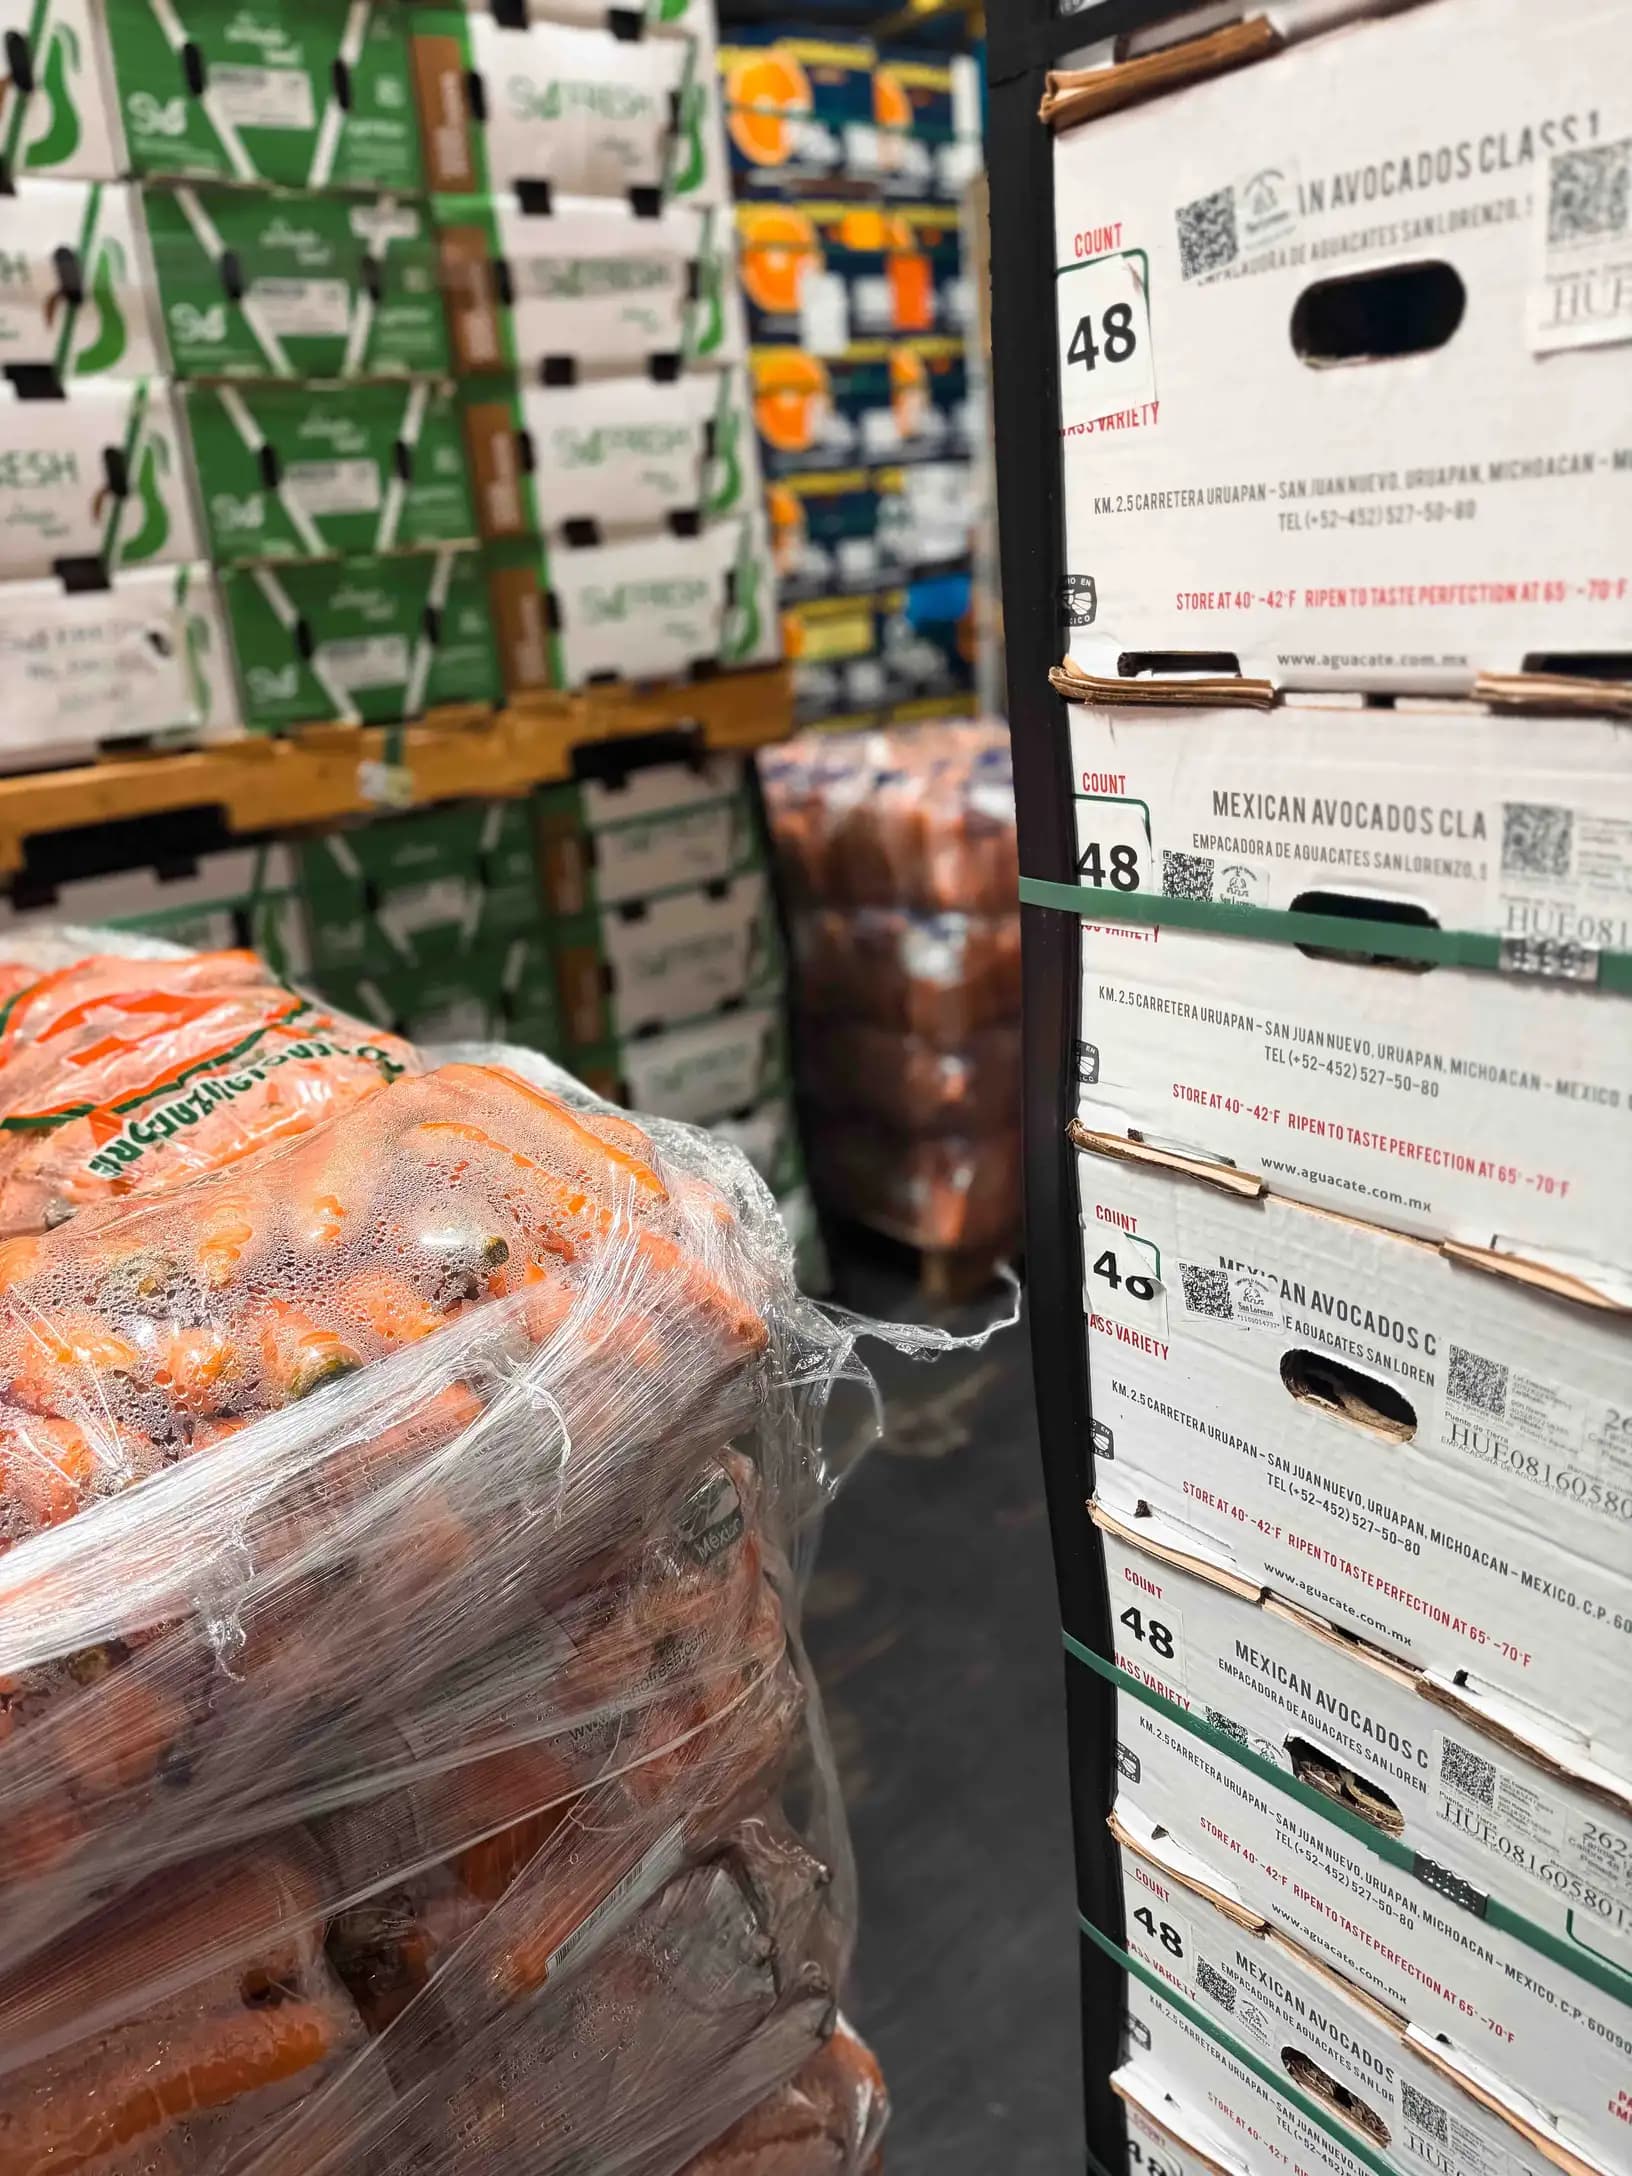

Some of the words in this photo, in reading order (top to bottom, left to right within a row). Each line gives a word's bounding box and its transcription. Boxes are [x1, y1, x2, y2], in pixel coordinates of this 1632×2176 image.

[1331, 142, 1472, 210] AVOCADOS
[1074, 222, 1122, 257] COUNT
[1067, 302, 1137, 372] 48
[1093, 496, 1115, 515] KM.
[1116, 494, 1135, 513] 2.5
[1135, 488, 1204, 511] CARRETERA
[1206, 483, 1267, 505] URUAPAN
[1278, 479, 1306, 500] SAN
[1278, 511, 1302, 531] TEL
[1176, 592, 1215, 611] STORE
[1217, 591, 1232, 609] AT
[1305, 587, 1347, 609] RIPEN
[1082, 772, 1126, 795] COUNT
[1212, 790, 1306, 825] MEXICAN
[1312, 798, 1434, 834] AVOCADOS
[1077, 842, 1140, 892] 48
[1192, 833, 1274, 857] EMPACADORA
[1275, 842, 1291, 858] DE
[1294, 844, 1370, 868] AGUACATES
[1374, 852, 1400, 871] SAN
[1098, 985, 1118, 1003] KM.
[1118, 990, 1135, 1006] 2.5
[1136, 994, 1198, 1022] CARRETERA
[1200, 1007, 1254, 1032] URUAPAN
[1265, 1020, 1290, 1041] SAN
[1292, 1027, 1325, 1048] JUAN
[1326, 1034, 1375, 1059] NUEVO,
[1377, 1043, 1447, 1074] URUAPAN,
[1450, 1057, 1541, 1092] MICHOACAN
[1264, 1045, 1286, 1064] TEL
[1288, 1049, 1358, 1080] (+52-452)
[1360, 1066, 1440, 1098] 527-50-80
[1173, 1083, 1208, 1106] STORE
[1209, 1094, 1222, 1109] AT
[1288, 1113, 1325, 1137] RIPEN
[1328, 1123, 1344, 1141] TO
[1347, 1127, 1387, 1152] TASTE
[1390, 1138, 1475, 1175] PERFECTION
[1478, 1161, 1495, 1179] AT
[1261, 1156, 1432, 1213] www.aguacate.com.mx
[1096, 1204, 1138, 1233] COUNT
[1115, 1326, 1169, 1360] VARIETY
[1295, 1319, 1364, 1358] AGUACATES
[1367, 1347, 1391, 1369] SAN
[1310, 1290, 1419, 1349] AVOCADOS
[1112, 1379, 1129, 1399] KM.
[1130, 1389, 1146, 1406] 2.5
[1147, 1396, 1206, 1434] CARRETERA
[1207, 1424, 1257, 1458] URUAPAN
[1267, 1452, 1290, 1474] SAN
[1292, 1464, 1322, 1488] JUAN
[1323, 1477, 1365, 1510] NUEVO,
[1367, 1498, 1428, 1540] URUAPAN,
[1430, 1528, 1508, 1577] MICHOACAN
[1267, 1472, 1287, 1493] TEL
[1289, 1482, 1349, 1523] (+52-452)
[1352, 1513, 1421, 1556] 527-50-80
[1124, 1567, 1163, 1599] COUNT
[1183, 1481, 1216, 1507] STORE
[1217, 1499, 1229, 1514] AT
[1288, 1534, 1321, 1561] RIPEN
[1323, 1550, 1337, 1568] TO
[1339, 1558, 1374, 1588] TASTE
[1376, 1578, 1450, 1627] PERFECTION
[1452, 1617, 1468, 1635] AT
[1263, 1562, 1412, 1646] www.aguacate.com.mx
[1120, 1606, 1175, 1659] 48
[1143, 1671, 1191, 1712] VARIETY
[1219, 1658, 1285, 1708] EMPACADORA
[1286, 1702, 1299, 1717] DE
[1301, 1709, 1363, 1755] AGUACATES
[1365, 1748, 1388, 1770] SAN
[1235, 1640, 1311, 1700] MEXICAN
[1315, 1689, 1412, 1760] AVOCADOS
[1136, 1868, 1170, 1903] COUNT
[1139, 1716, 1156, 1735] KM.
[1156, 1728, 1170, 1745] 2.5
[1171, 1739, 1222, 1781] CARRETERA
[1224, 1775, 1267, 1814] URUAPAN
[1276, 1813, 1297, 1837] SAN
[1298, 1827, 1324, 1852] JUAN
[1326, 1843, 1364, 1881] NUEVO,
[1423, 1909, 1494, 1965] MICHOACAN
[1587, 2017, 1632, 2055] 60090
[1275, 1829, 1293, 1850] TEL
[1294, 1840, 1350, 1887] (+52-452)
[1351, 1881, 1414, 1930] 527-50-80
[1133, 1906, 1184, 1959] 48
[1200, 1817, 1229, 1845] STORE
[1230, 1839, 1241, 1854] AT
[1293, 1884, 1323, 1913] RIPEN
[1325, 1905, 1338, 1922] TO
[1339, 1915, 1372, 1947] TASTE
[1373, 1937, 1441, 1993] PERFECTION
[1443, 1988, 1456, 2005] AT
[1272, 1903, 1408, 2005] www.aguacate.com.mx
[1221, 1962, 1281, 2016] EMPACADORA
[1282, 2012, 1294, 2028] DE
[1296, 2022, 1351, 2071] AGUACATES
[1353, 2064, 1374, 2090] SAN
[1236, 1951, 1305, 2016] MEXICAN
[1309, 2007, 1395, 2084] AVOCADOS
[1178, 2018, 1227, 2065] CARRETERA
[1228, 2060, 1269, 2101] URUAPAN
[1276, 2098, 1295, 2123] SAN
[1207, 2090, 1234, 2120] STORE
[1235, 2115, 1246, 2130] AT
[1276, 2115, 1292, 2137] TEL
